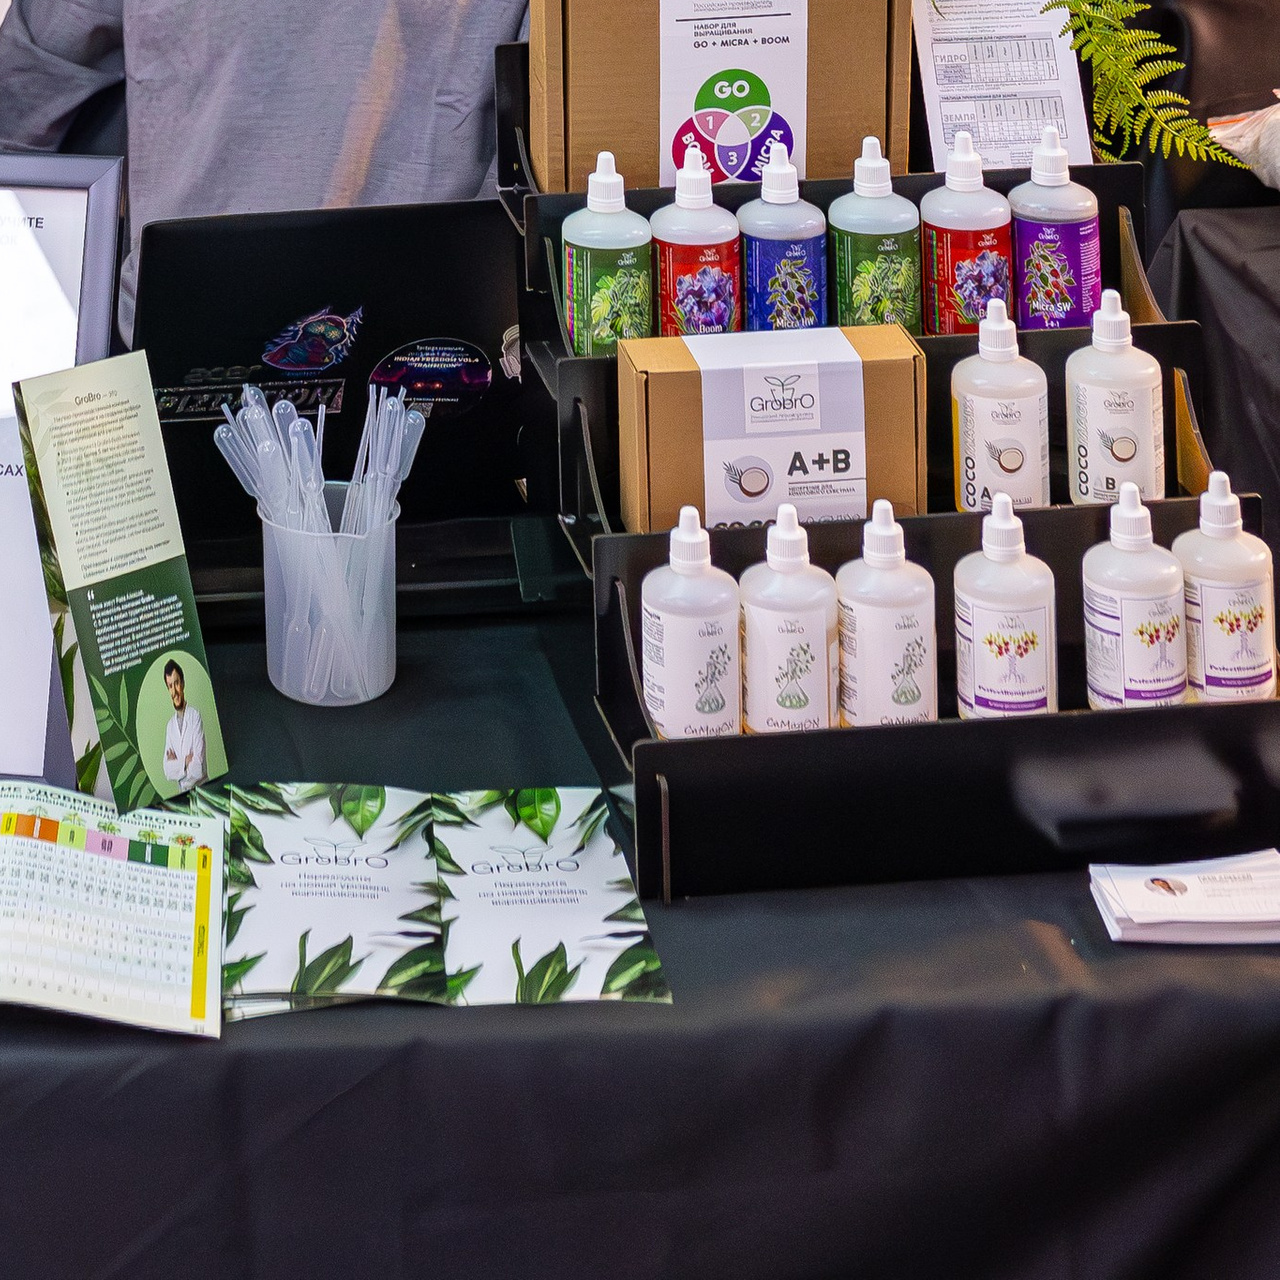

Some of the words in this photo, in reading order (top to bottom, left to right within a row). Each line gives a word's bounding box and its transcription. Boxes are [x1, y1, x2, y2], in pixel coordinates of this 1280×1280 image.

[693, 28, 753, 37] ВЫРАЩИВАНИЯ
[721, 22, 737, 30] ДЛЯ
[693, 41, 708, 49] GO
[720, 38, 750, 47] MICRA
[761, 36, 790, 45] BOOM
[714, 80, 750, 99] GO
[706, 116, 714, 129] 1
[750, 113, 761, 127] 2
[727, 151, 738, 166] 3
[1057, 302, 1071, 312] SW
[699, 324, 723, 334] Boom
[74, 392, 101, 407] GroBro
[750, 393, 815, 412] GrobrO
